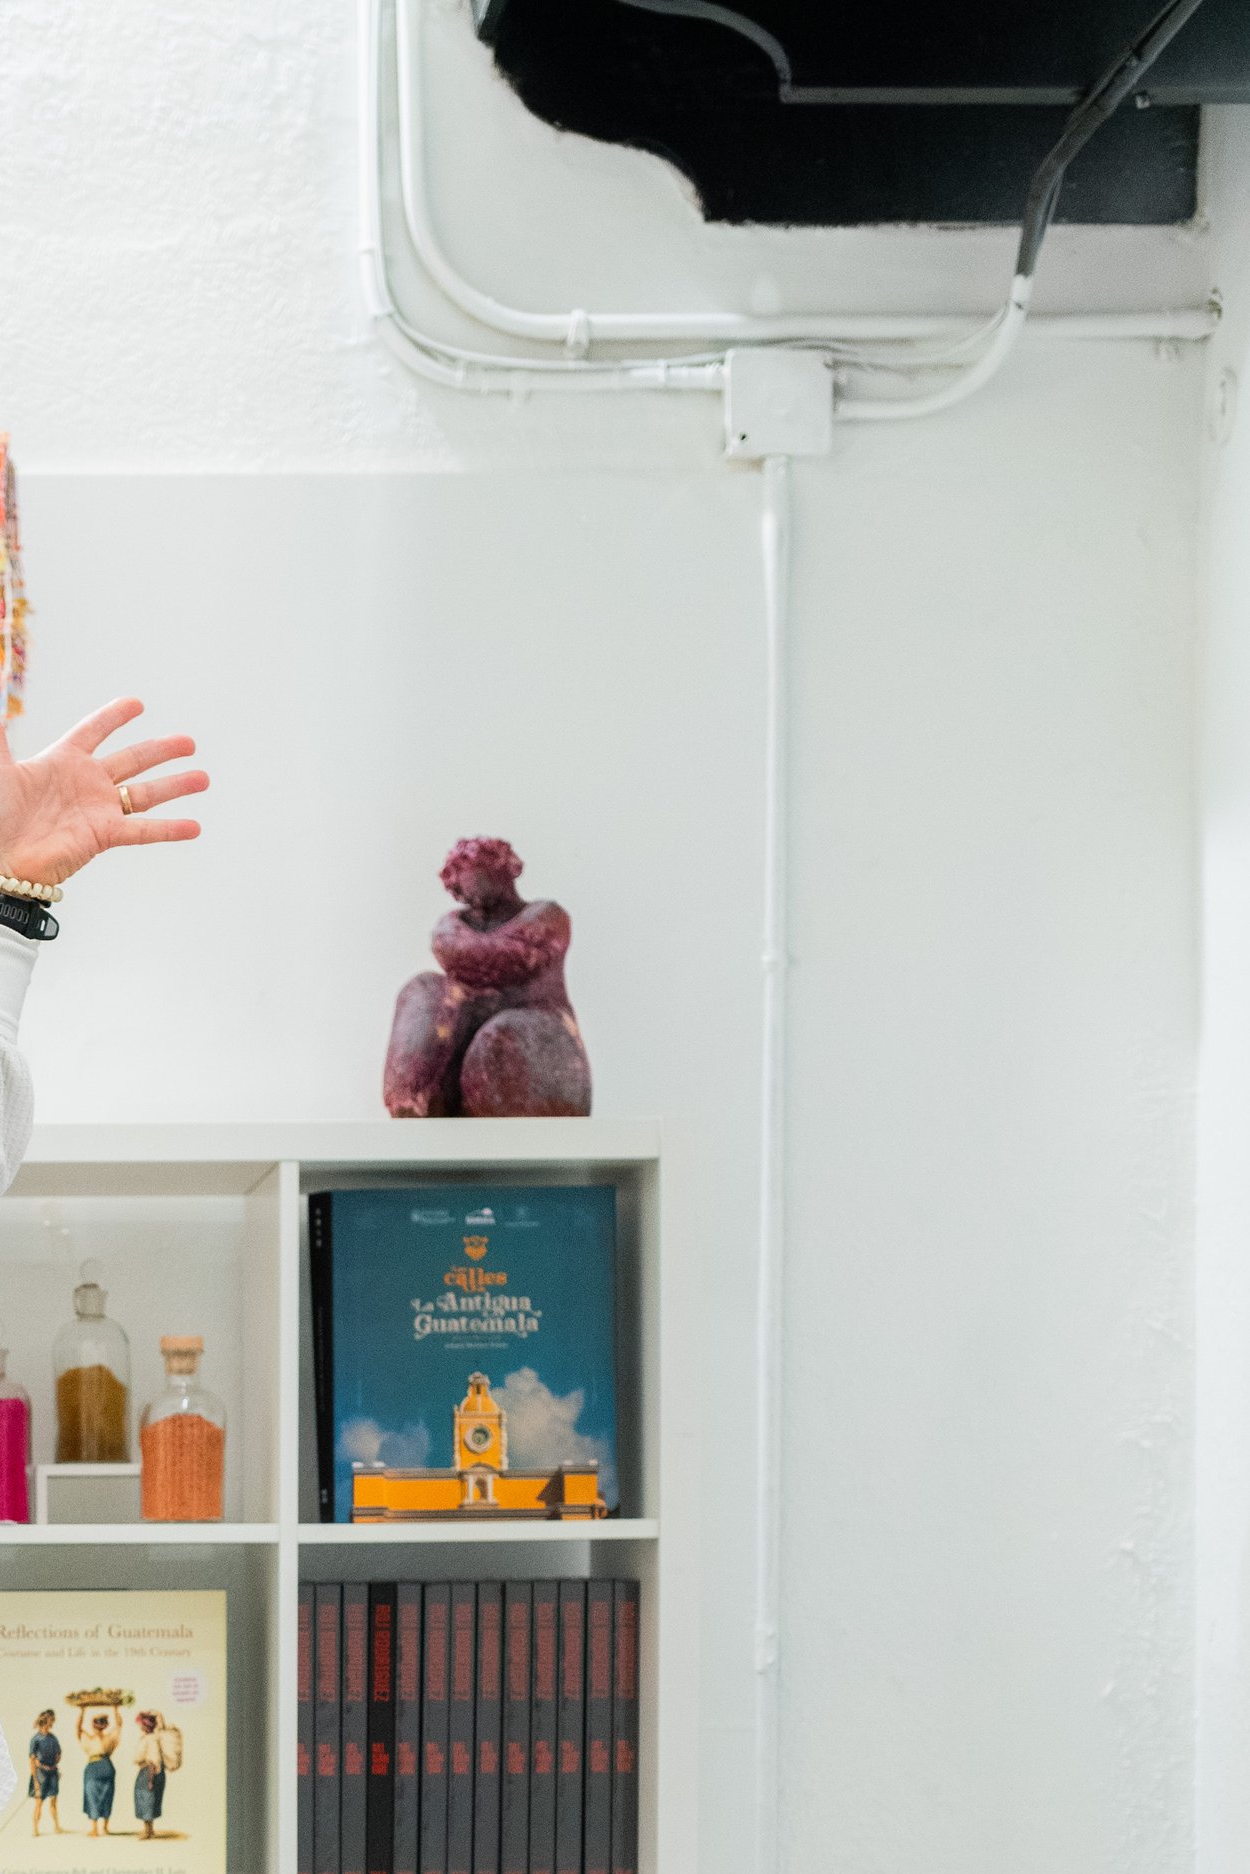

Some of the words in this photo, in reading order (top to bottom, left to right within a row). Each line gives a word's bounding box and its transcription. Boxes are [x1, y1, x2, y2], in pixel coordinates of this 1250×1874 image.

[414, 1312, 540, 1341] Guatemala
[84, 1624, 101, 1640] of
[107, 1623, 194, 1640] Guatemala
